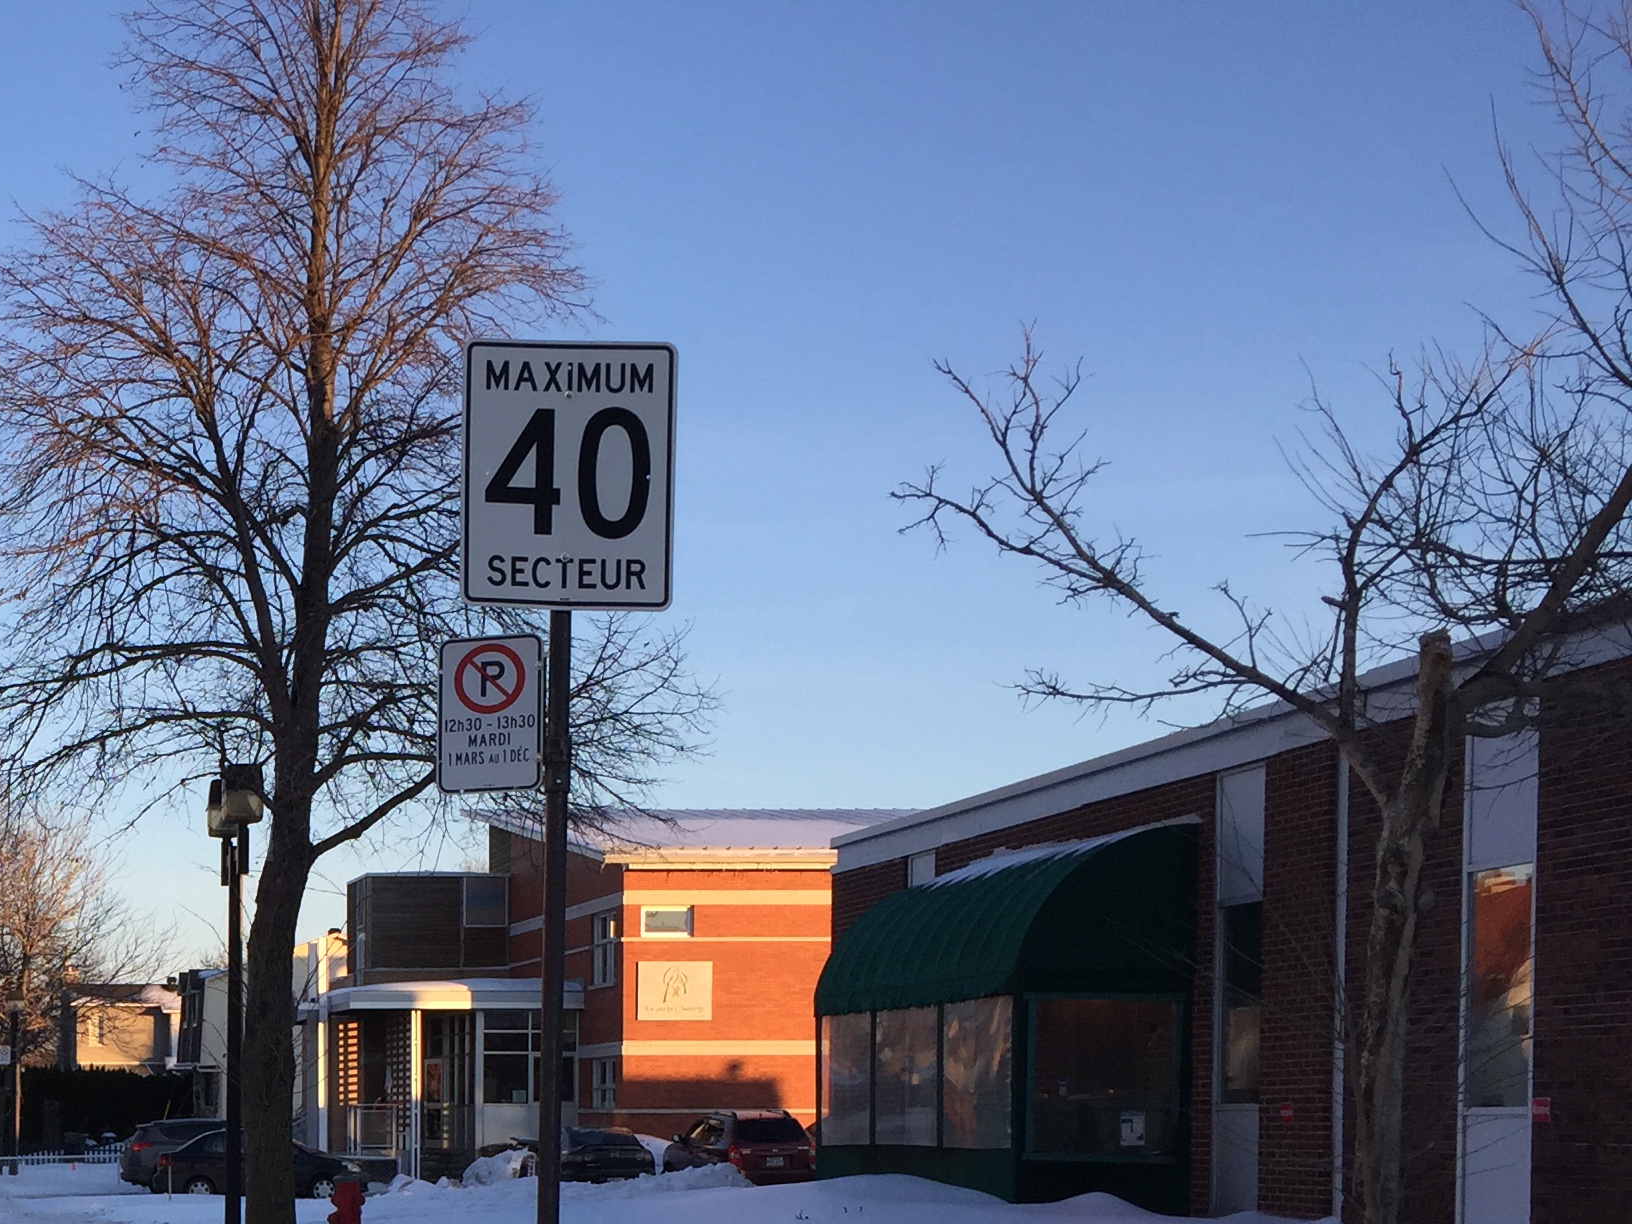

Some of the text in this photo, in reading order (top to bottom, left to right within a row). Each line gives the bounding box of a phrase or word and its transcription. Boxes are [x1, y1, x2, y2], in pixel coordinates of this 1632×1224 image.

[485, 360, 655, 394] MAXIMUM
[484, 406, 652, 540] 40
[486, 554, 646, 591] SECTEUR
[444, 717, 482, 733] 12h30
[496, 713, 536, 730] 13h30
[468, 732, 511, 748] MARDI
[455, 751, 485, 766] MARS
